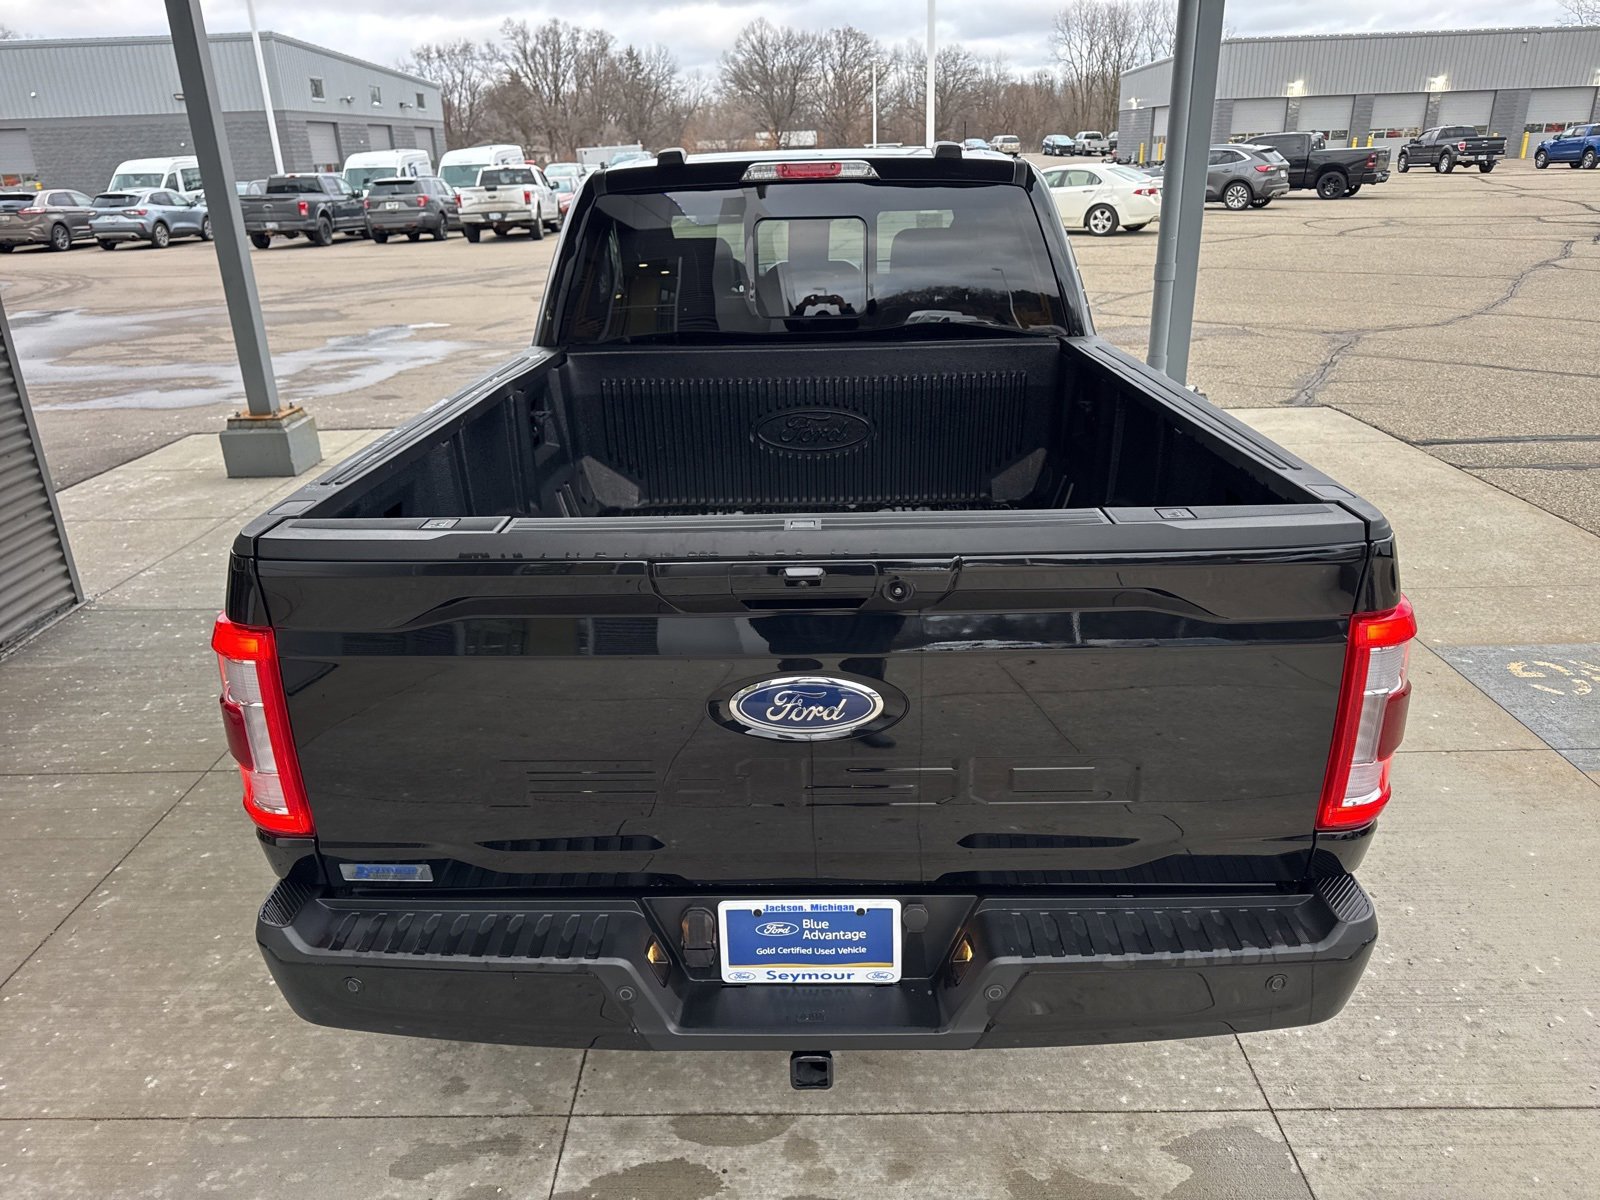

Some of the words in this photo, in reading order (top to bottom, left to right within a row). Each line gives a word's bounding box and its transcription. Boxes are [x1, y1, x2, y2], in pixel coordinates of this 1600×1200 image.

[780, 414, 850, 442] Ford
[766, 690, 848, 722] Ford
[810, 904, 855, 912] Michigan
[763, 924, 791, 935] Ford
[802, 919, 830, 929] Blue
[802, 929, 867, 941] Advantage
[756, 947, 776, 955] Gold
[777, 946, 812, 955] Certified
[814, 947, 836, 955] Used
[837, 946, 867, 954] Vehicle
[766, 970, 855, 983] Seymour
